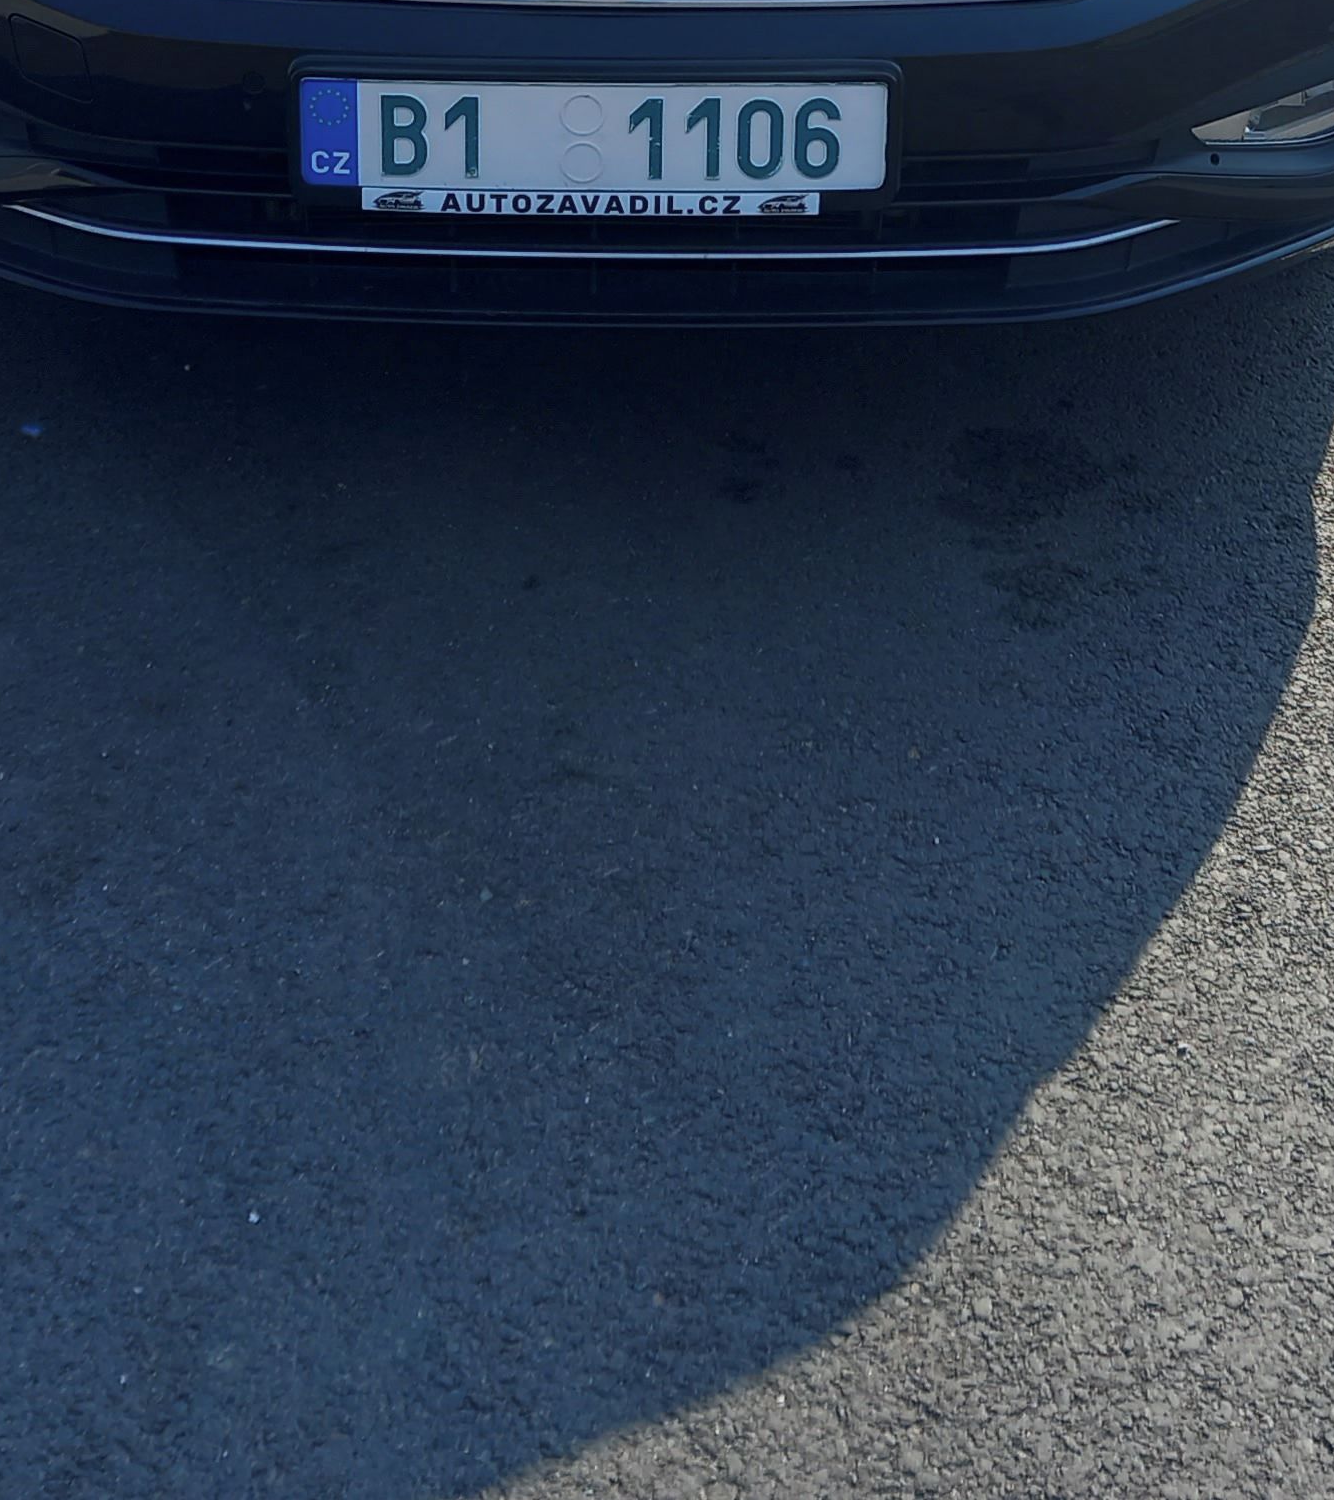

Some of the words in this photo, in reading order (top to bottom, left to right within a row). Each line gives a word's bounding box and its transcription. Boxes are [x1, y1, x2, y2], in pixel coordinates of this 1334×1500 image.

[379, 94, 480, 179] B1
[628, 96, 842, 181] 1106
[310, 150, 351, 175] CZ
[440, 192, 742, 216] AUTOZAVADIL.CZ
